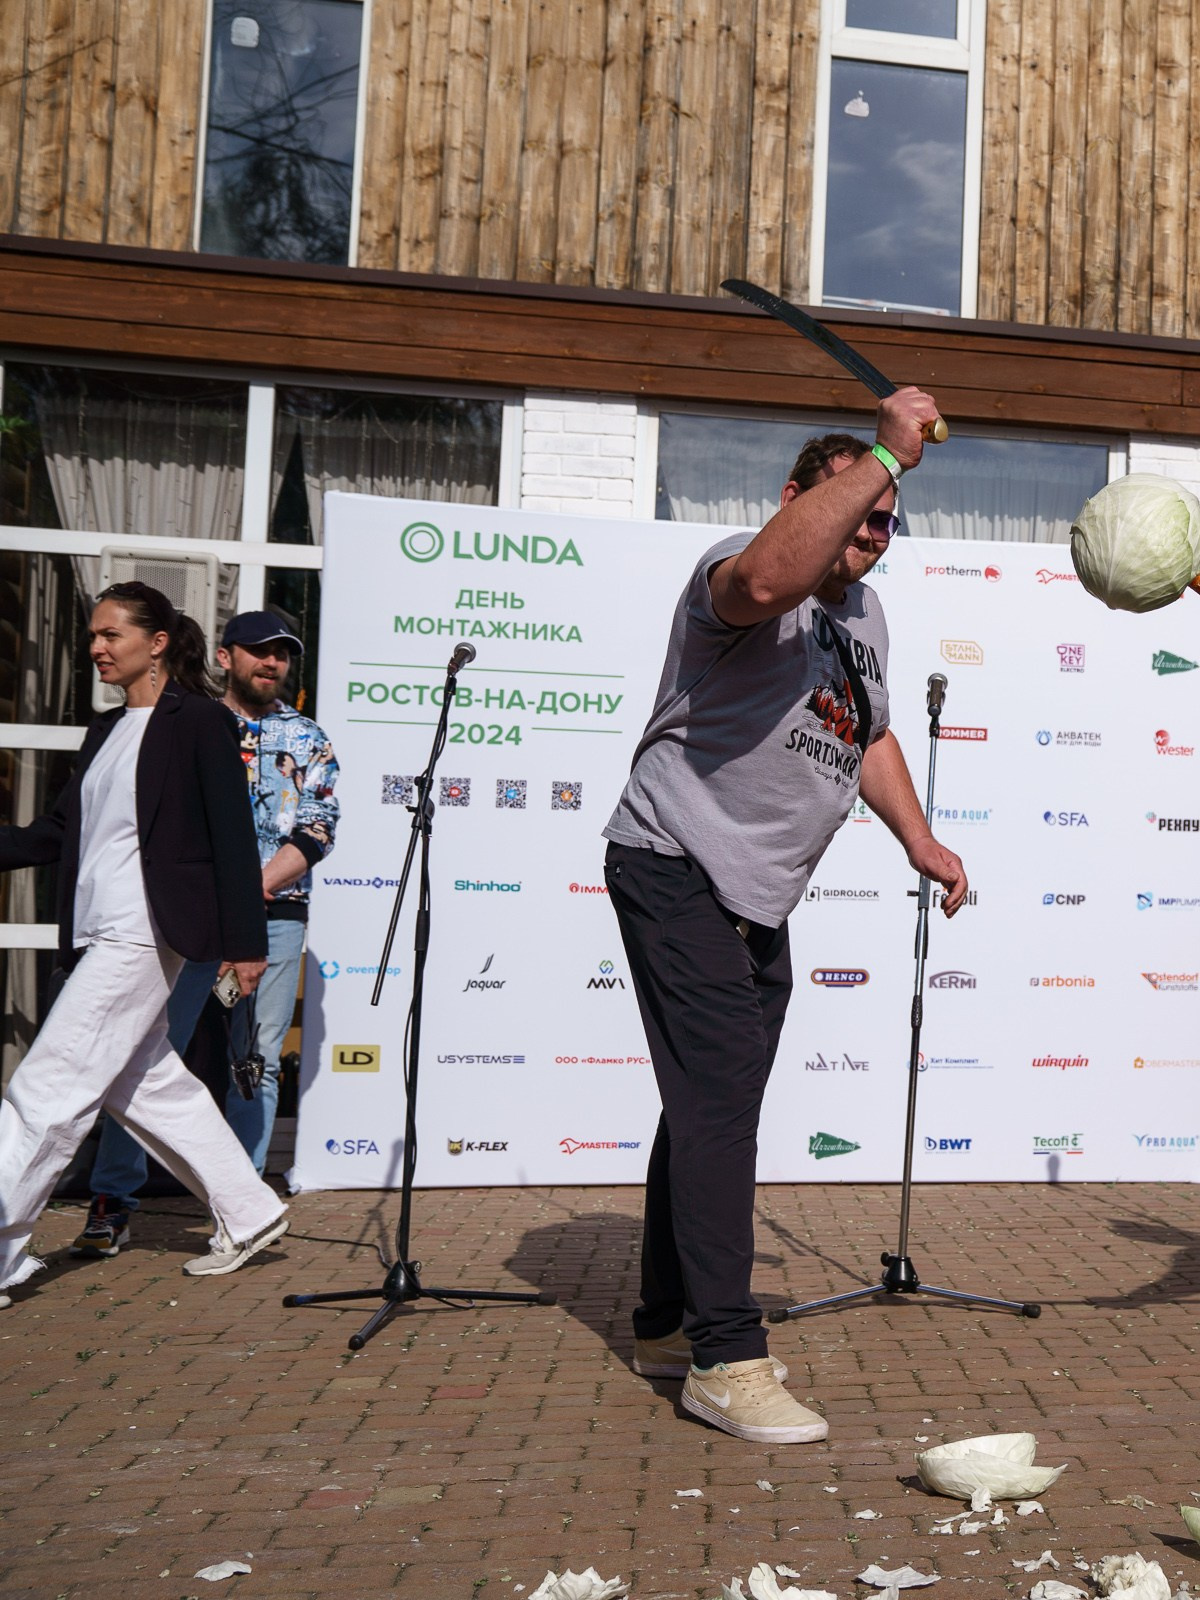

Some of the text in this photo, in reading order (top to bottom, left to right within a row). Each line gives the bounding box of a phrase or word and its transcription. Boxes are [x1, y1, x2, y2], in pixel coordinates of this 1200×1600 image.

[453, 530, 584, 566] LUNDA
[925, 565, 982, 577] protherm
[455, 589, 525, 609] ДЕНЬ
[394, 616, 583, 643] МОНТАЖНИКА
[1060, 655, 1082, 665] KEY
[347, 681, 623, 715] РОСТОВ-НА-ДОНУ
[449, 724, 522, 746] 2024
[1056, 731, 1102, 741] АКВАТЕК
[1156, 745, 1195, 756] Wester
[938, 809, 989, 820] PRO AQUA
[1058, 812, 1090, 826] SFA
[454, 880, 521, 892] Shinhoo
[823, 889, 880, 898] GIDROLOCK
[1055, 894, 1086, 905] CNP
[346, 966, 401, 976] oventop
[825, 972, 864, 981] HENCO
[1151, 972, 1199, 982] Ostendorf
[928, 972, 977, 989] KERMI
[1042, 975, 1095, 987] arbonia
[339, 1051, 374, 1065] LD
[555, 1056, 579, 1064] ООО
[805, 1052, 870, 1071] NATIVE
[343, 1139, 380, 1155] SFA
[466, 1142, 509, 1151] K-FLEX
[939, 1138, 972, 1150] BWT
[1033, 1136, 1069, 1147] Tecofi
[1146, 1137, 1196, 1148] PRO AQUA
